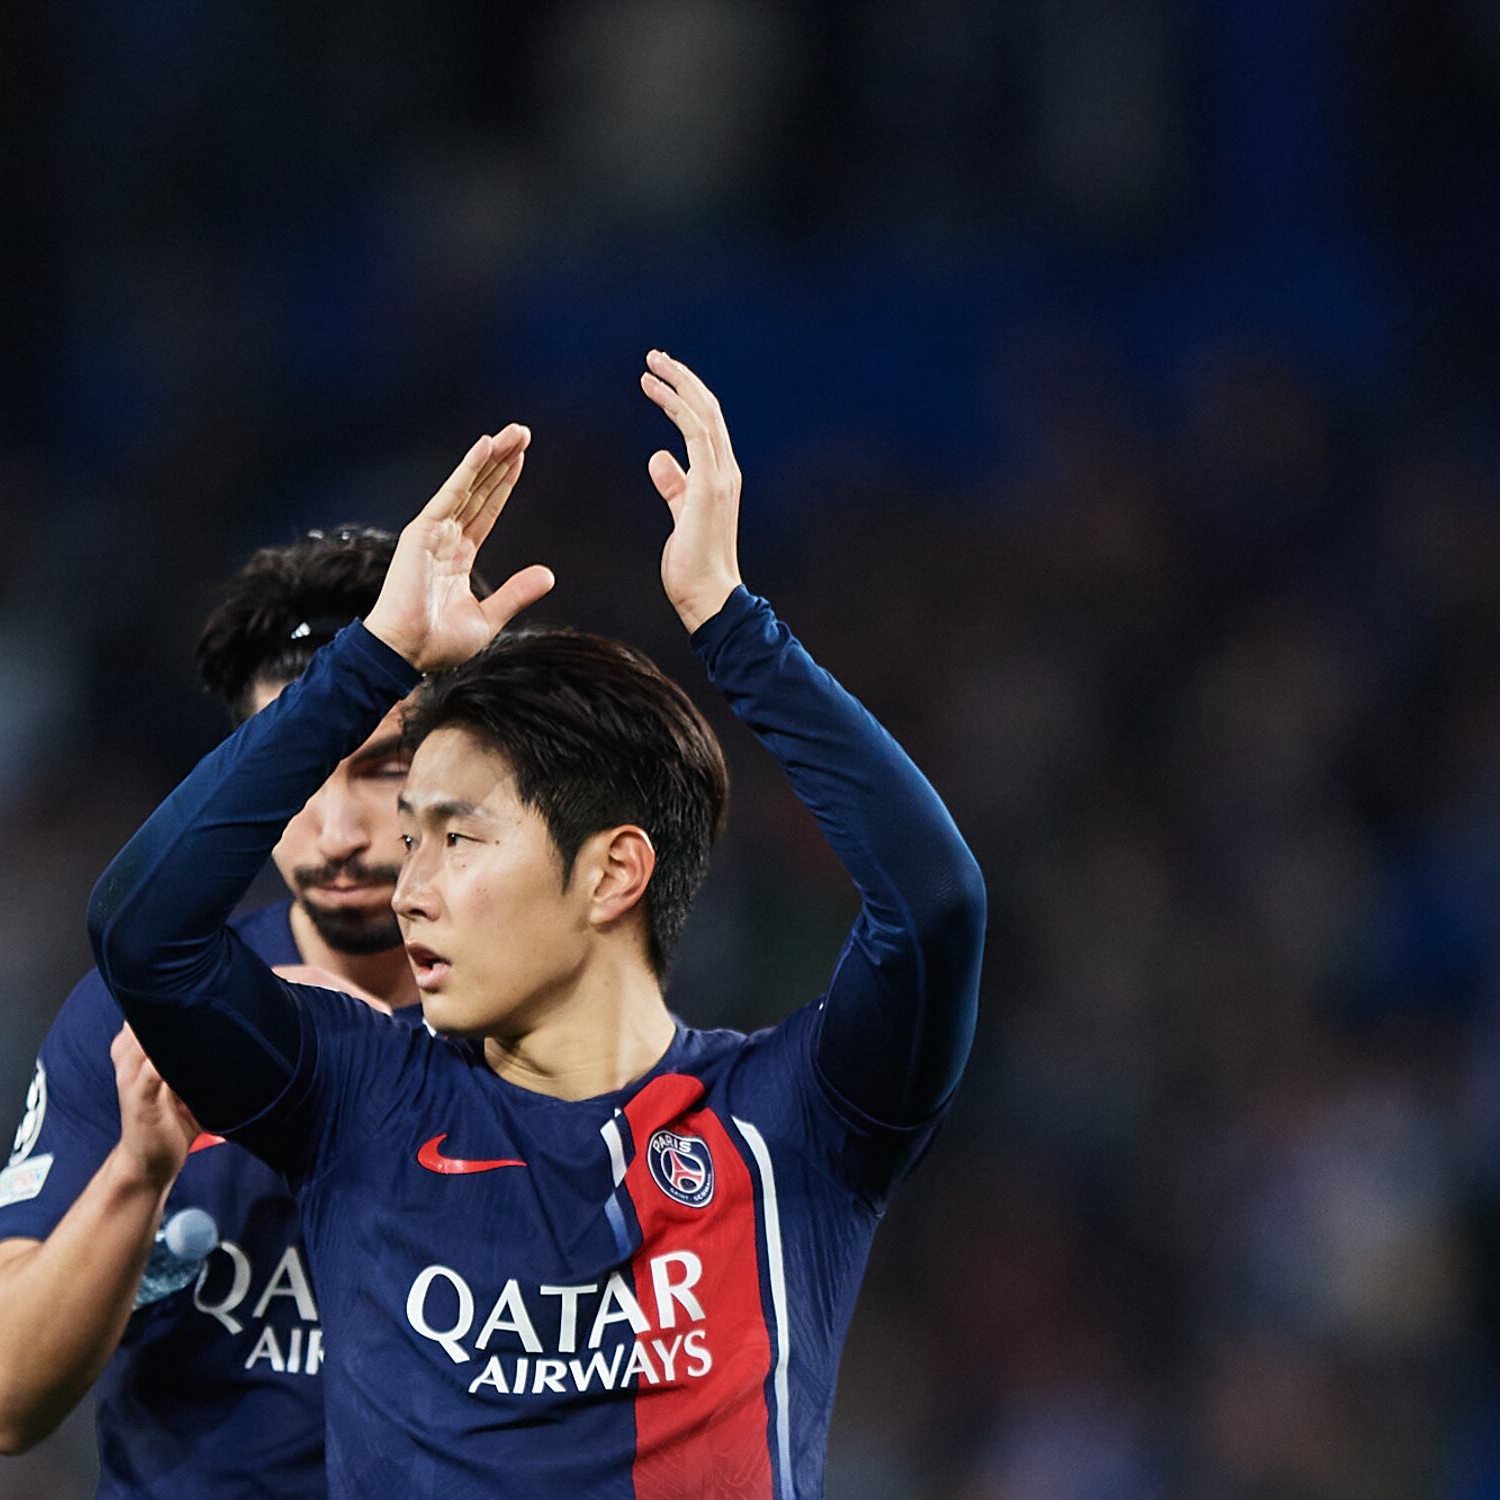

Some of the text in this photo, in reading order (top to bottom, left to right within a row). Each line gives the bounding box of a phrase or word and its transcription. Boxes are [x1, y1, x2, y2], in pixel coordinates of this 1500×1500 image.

[653, 1134, 691, 1153] PARIS
[406, 1251, 705, 1363] QATAR
[468, 1330, 713, 1394] AIRWAYS
